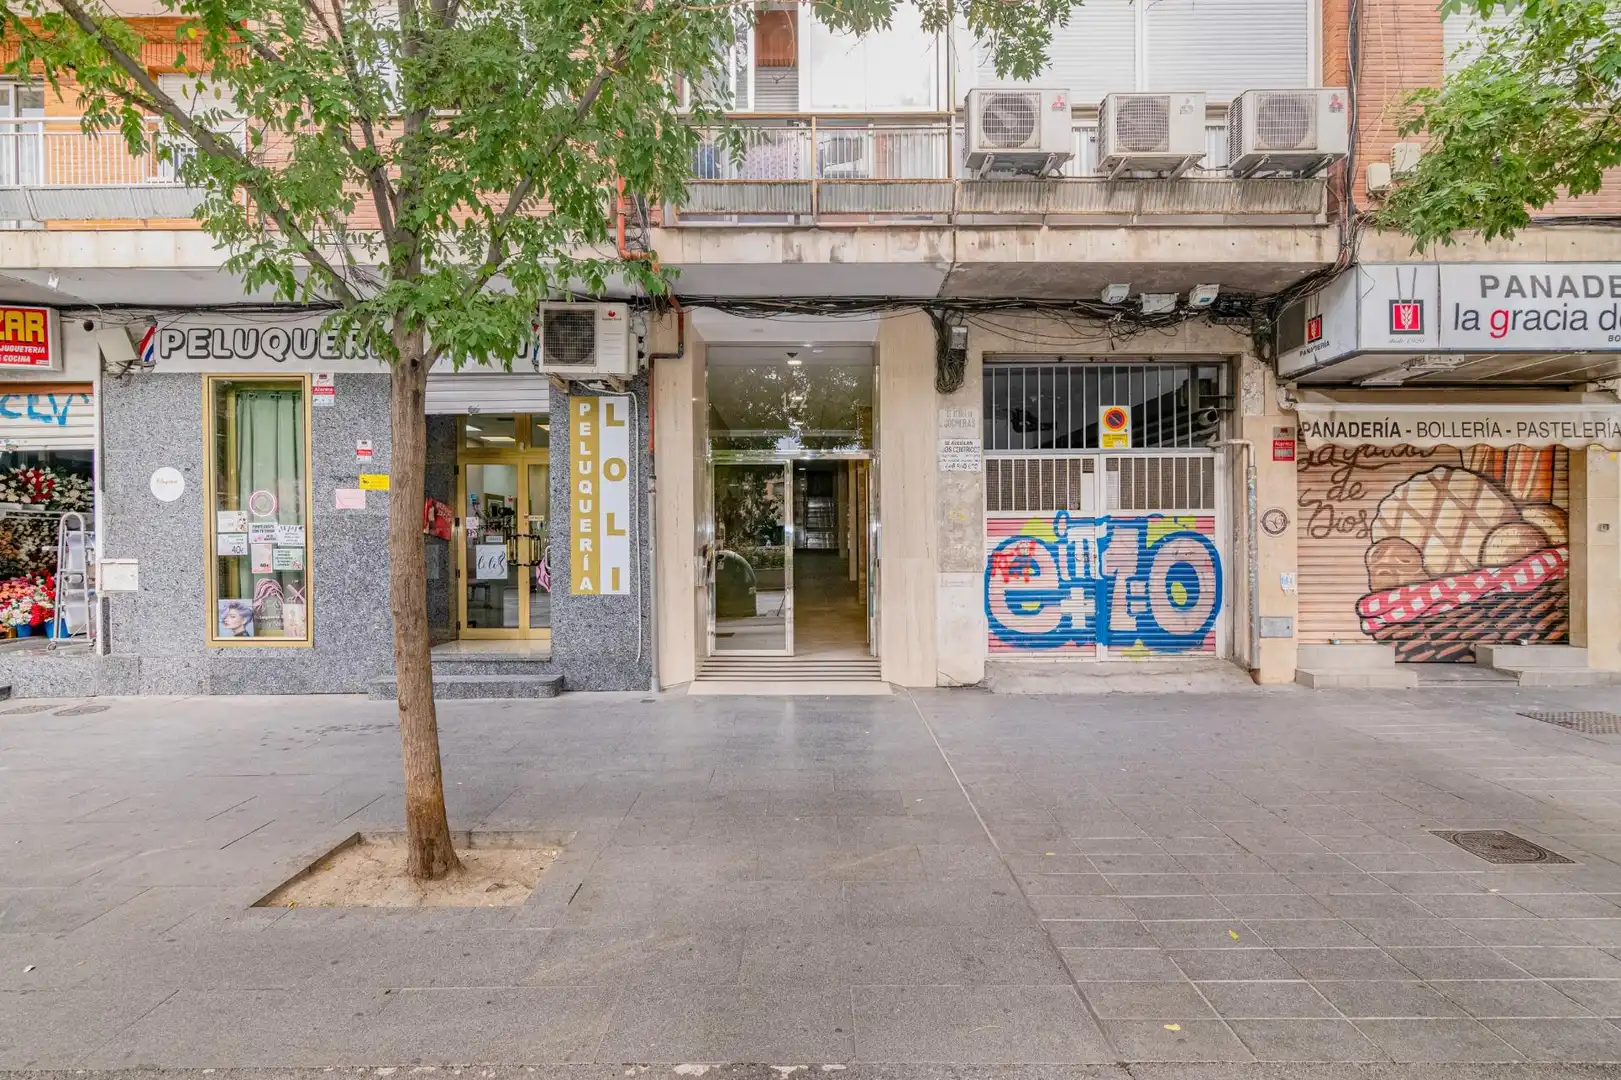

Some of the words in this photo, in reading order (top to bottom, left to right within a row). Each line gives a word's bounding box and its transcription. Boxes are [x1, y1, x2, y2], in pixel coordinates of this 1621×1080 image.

[0, 310, 45, 343] AR
[1454, 303, 1480, 331] la
[1490, 303, 1588, 338] gracia
[1598, 303, 1621, 331] d
[3, 355, 31, 363] COCINA
[1302, 417, 1401, 438] PANADERÍA
[1417, 418, 1502, 438] BOLLERÍA
[1517, 418, 1621, 438] PASTELERÍA
[578, 402, 593, 591] PELUQUERÍA
[603, 403, 627, 591] LOLI
